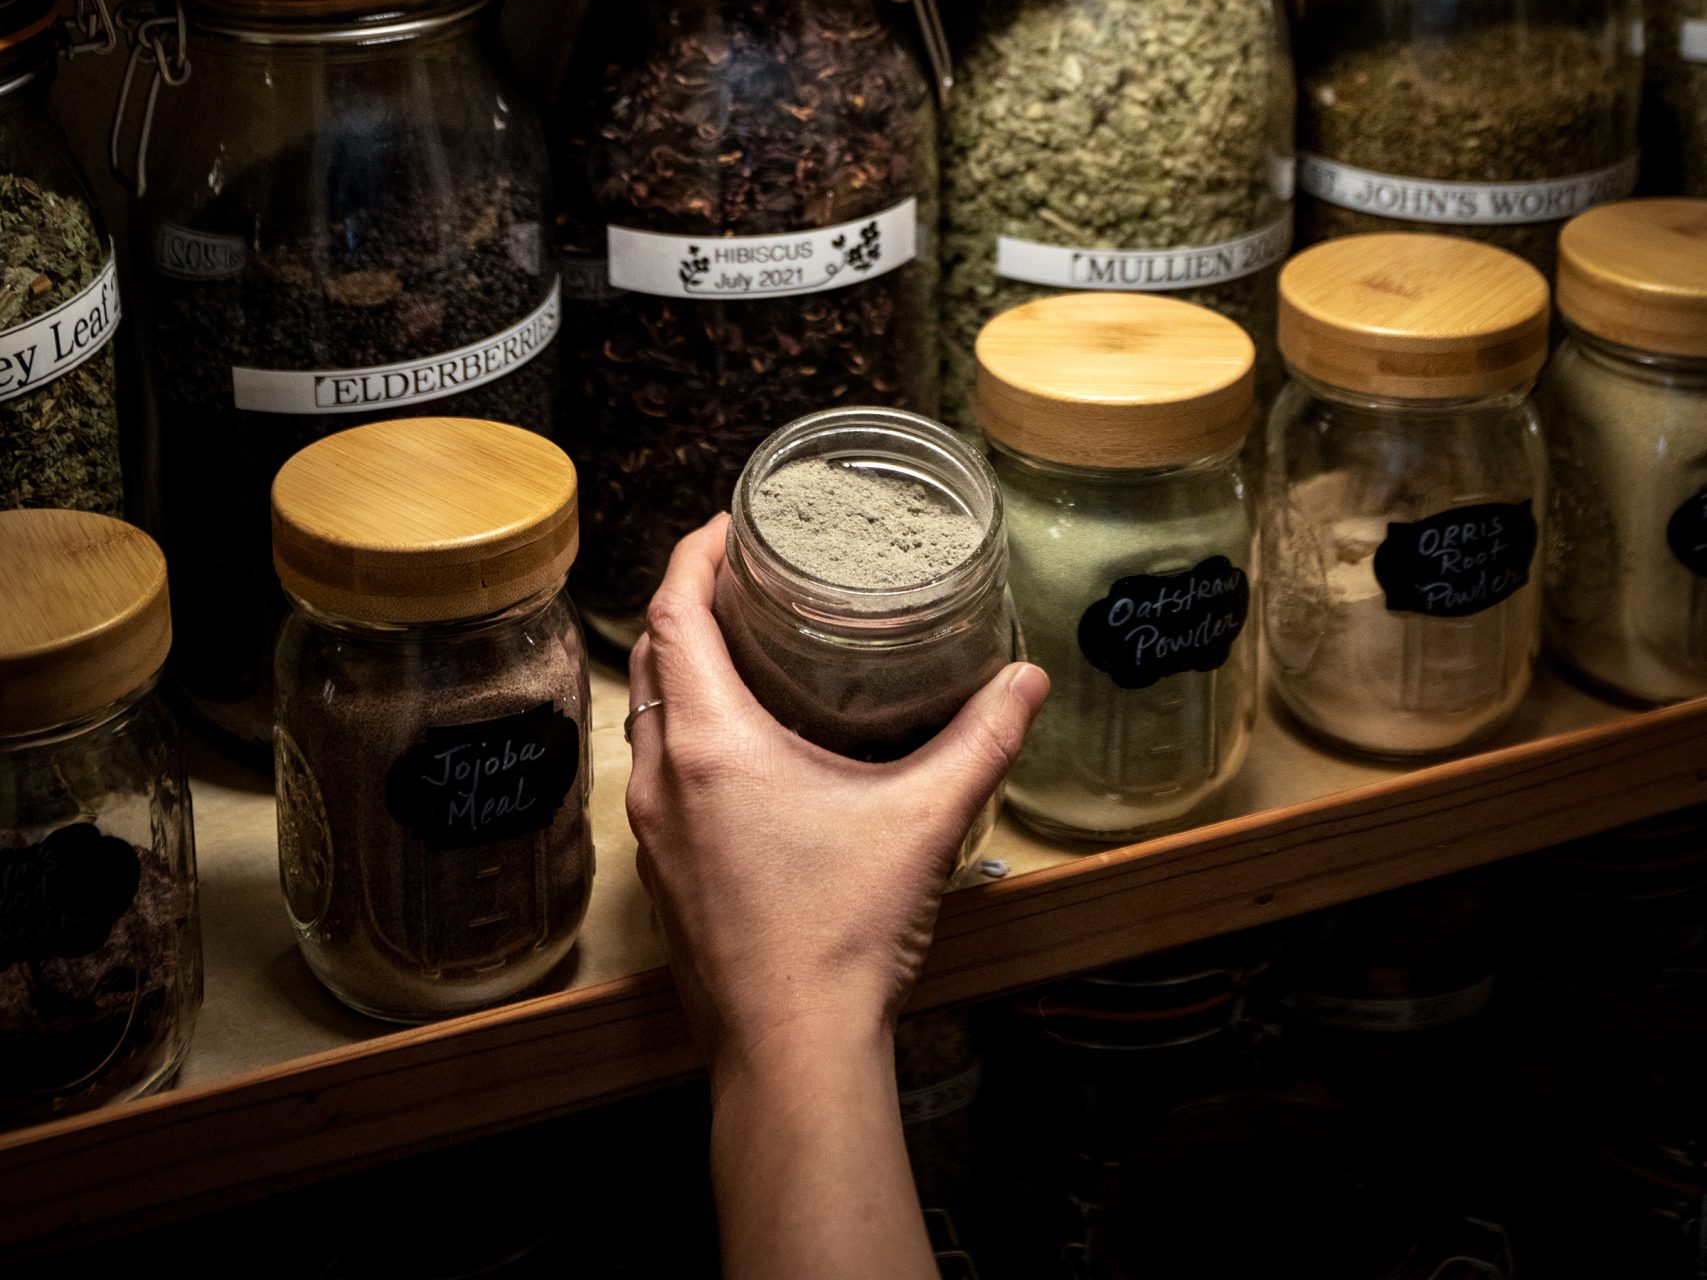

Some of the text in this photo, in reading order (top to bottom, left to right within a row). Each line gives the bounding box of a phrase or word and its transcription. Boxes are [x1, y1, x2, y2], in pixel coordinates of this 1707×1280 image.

[1355, 180, 1478, 219] JOHN'S
[1489, 187, 1580, 218] WORT
[714, 242, 815, 264] HIBISCUS
[1088, 252, 1234, 283] MULLIEN
[714, 269, 805, 290] July 2021
[50, 283, 110, 363] Leaf
[1430, 537, 1509, 576] Root
[1124, 611, 1239, 667] Powder
[421, 738, 546, 797] Jojoba
[447, 776, 536, 831] Meal
